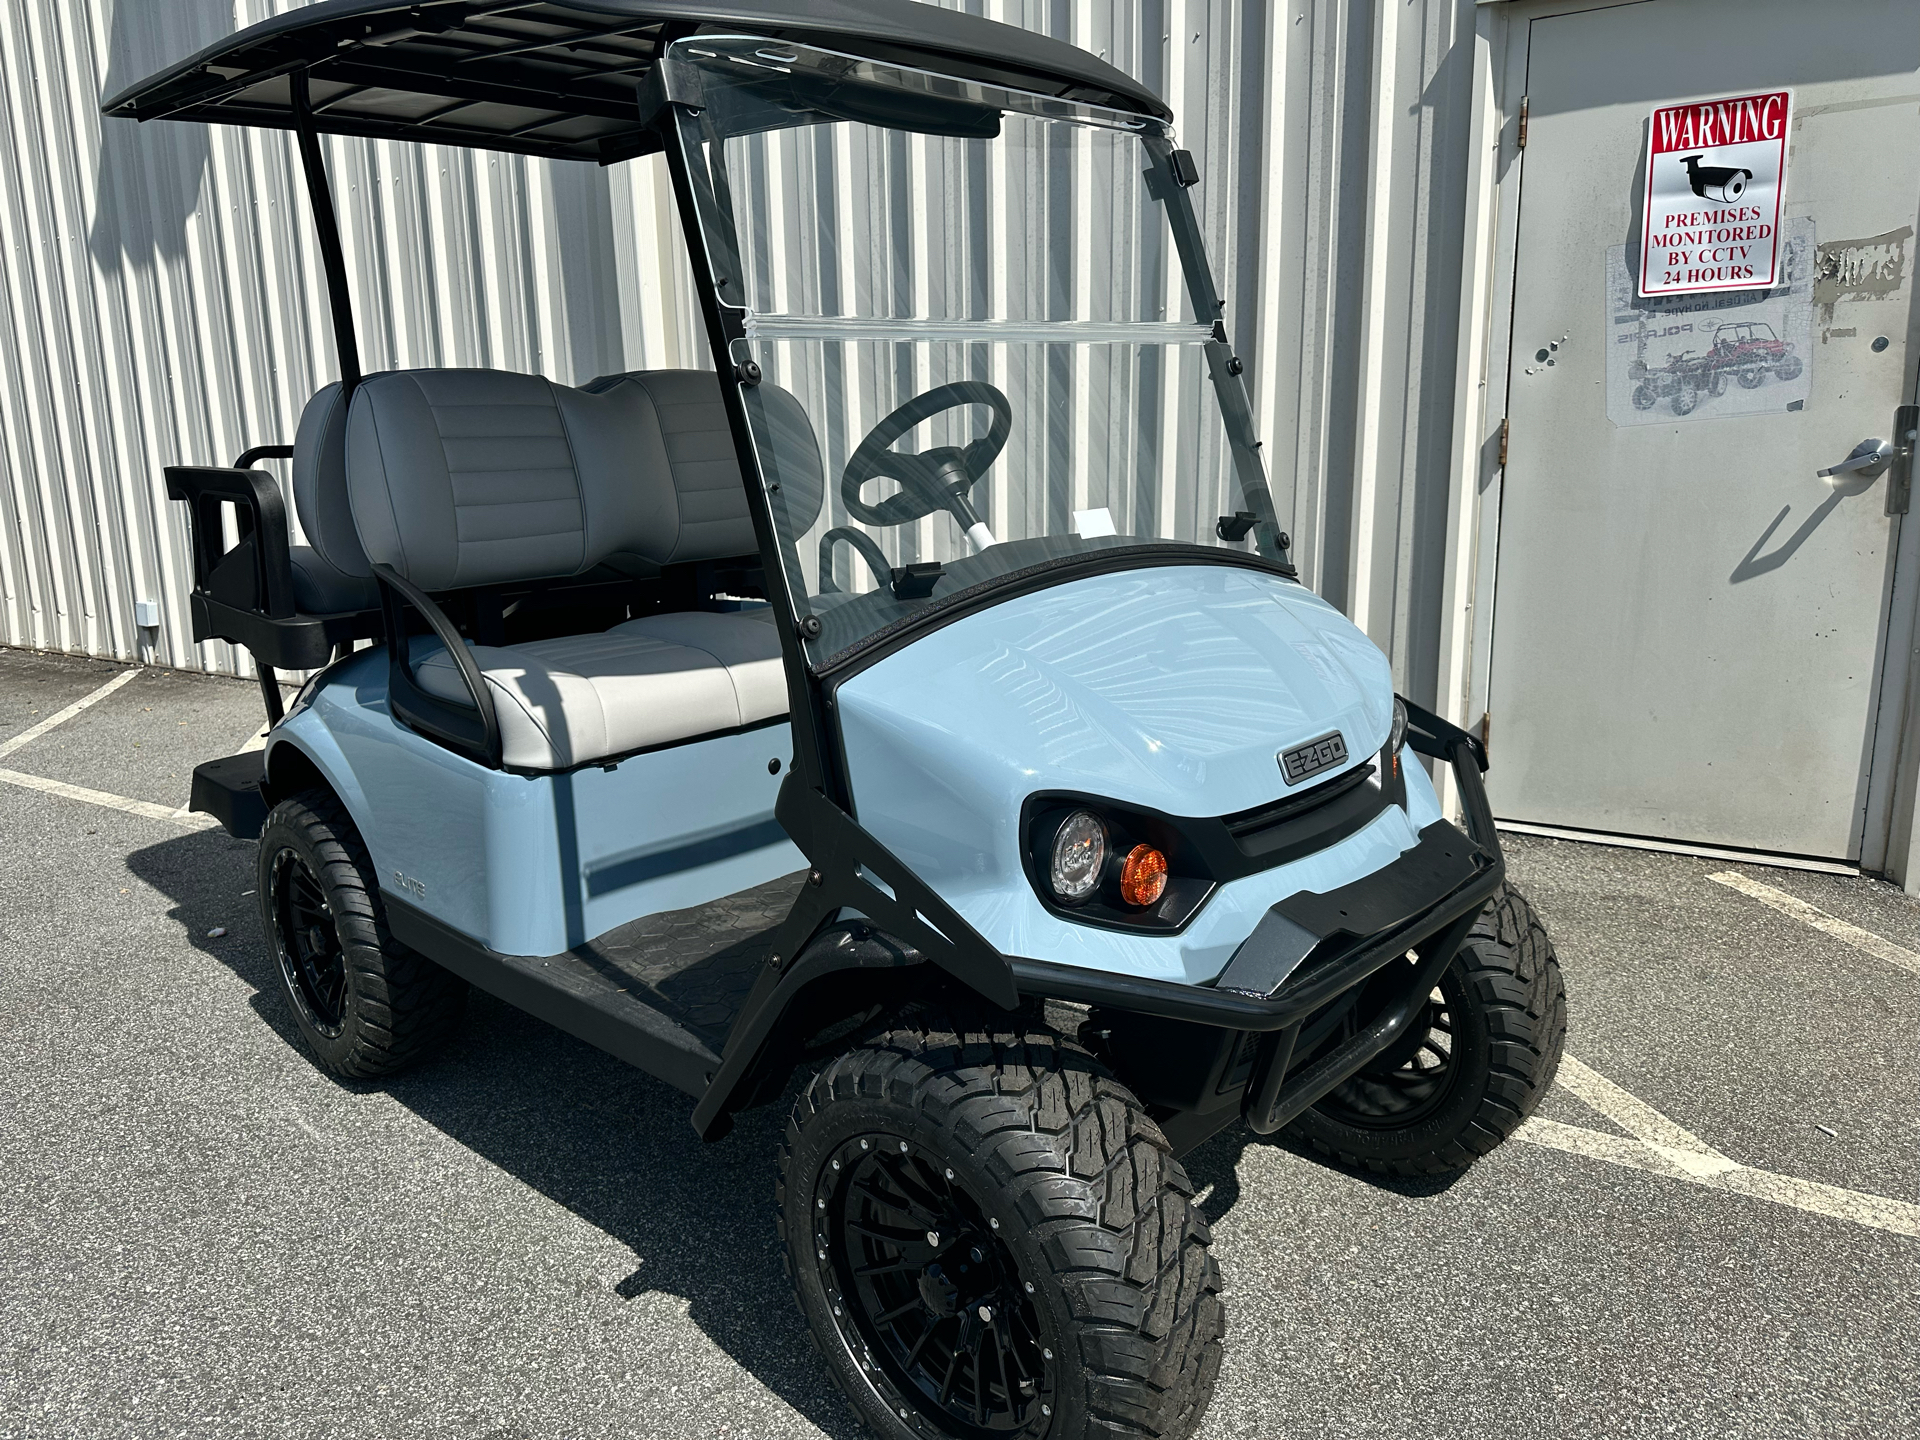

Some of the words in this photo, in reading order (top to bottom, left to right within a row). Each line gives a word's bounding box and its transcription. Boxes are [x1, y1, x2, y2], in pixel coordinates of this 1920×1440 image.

[1659, 95, 1782, 151] WARNING
[1664, 205, 1761, 229] PREMISES
[1651, 224, 1772, 249] MONITORED
[1668, 250, 1693, 266] BY
[1698, 245, 1752, 264] CCTV
[1663, 270, 1681, 285] 24
[1687, 264, 1754, 283] HOURS
[394, 870, 426, 898] ELITE
